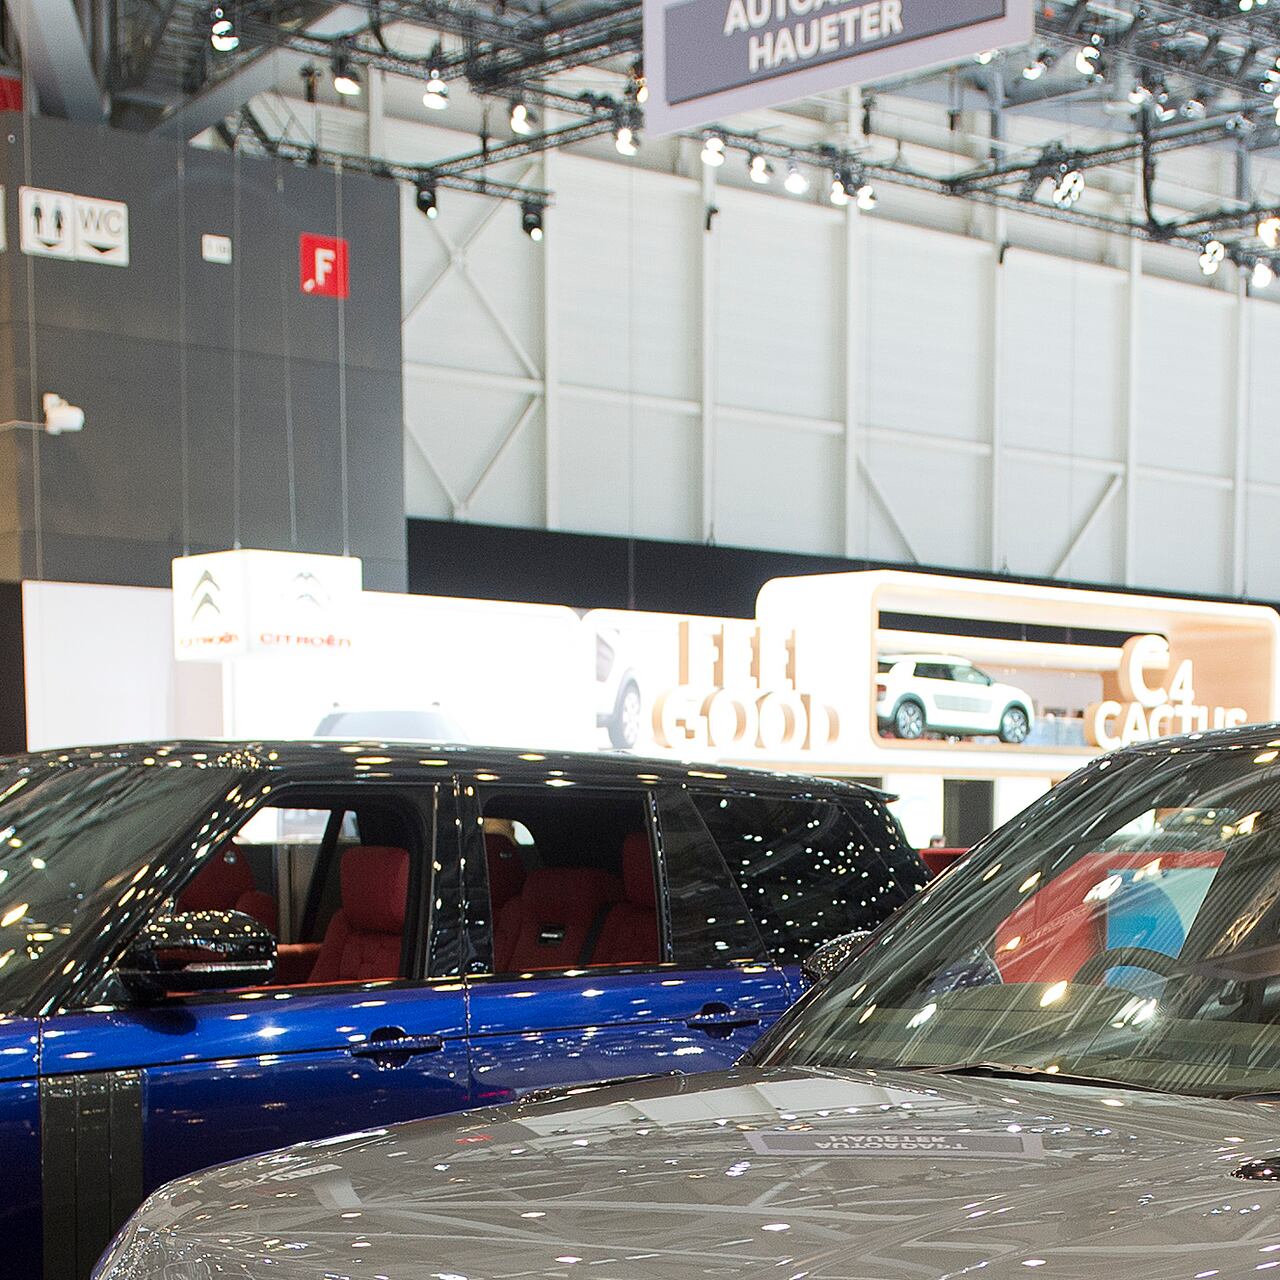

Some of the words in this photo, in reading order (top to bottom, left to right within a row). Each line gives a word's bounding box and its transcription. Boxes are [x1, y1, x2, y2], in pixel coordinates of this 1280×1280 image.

[748, 1, 904, 74] HAUETER
[78, 207, 122, 238] WC
[314, 247, 336, 287] F
[1121, 634, 1196, 709] C4
[651, 688, 840, 751] GOOD
